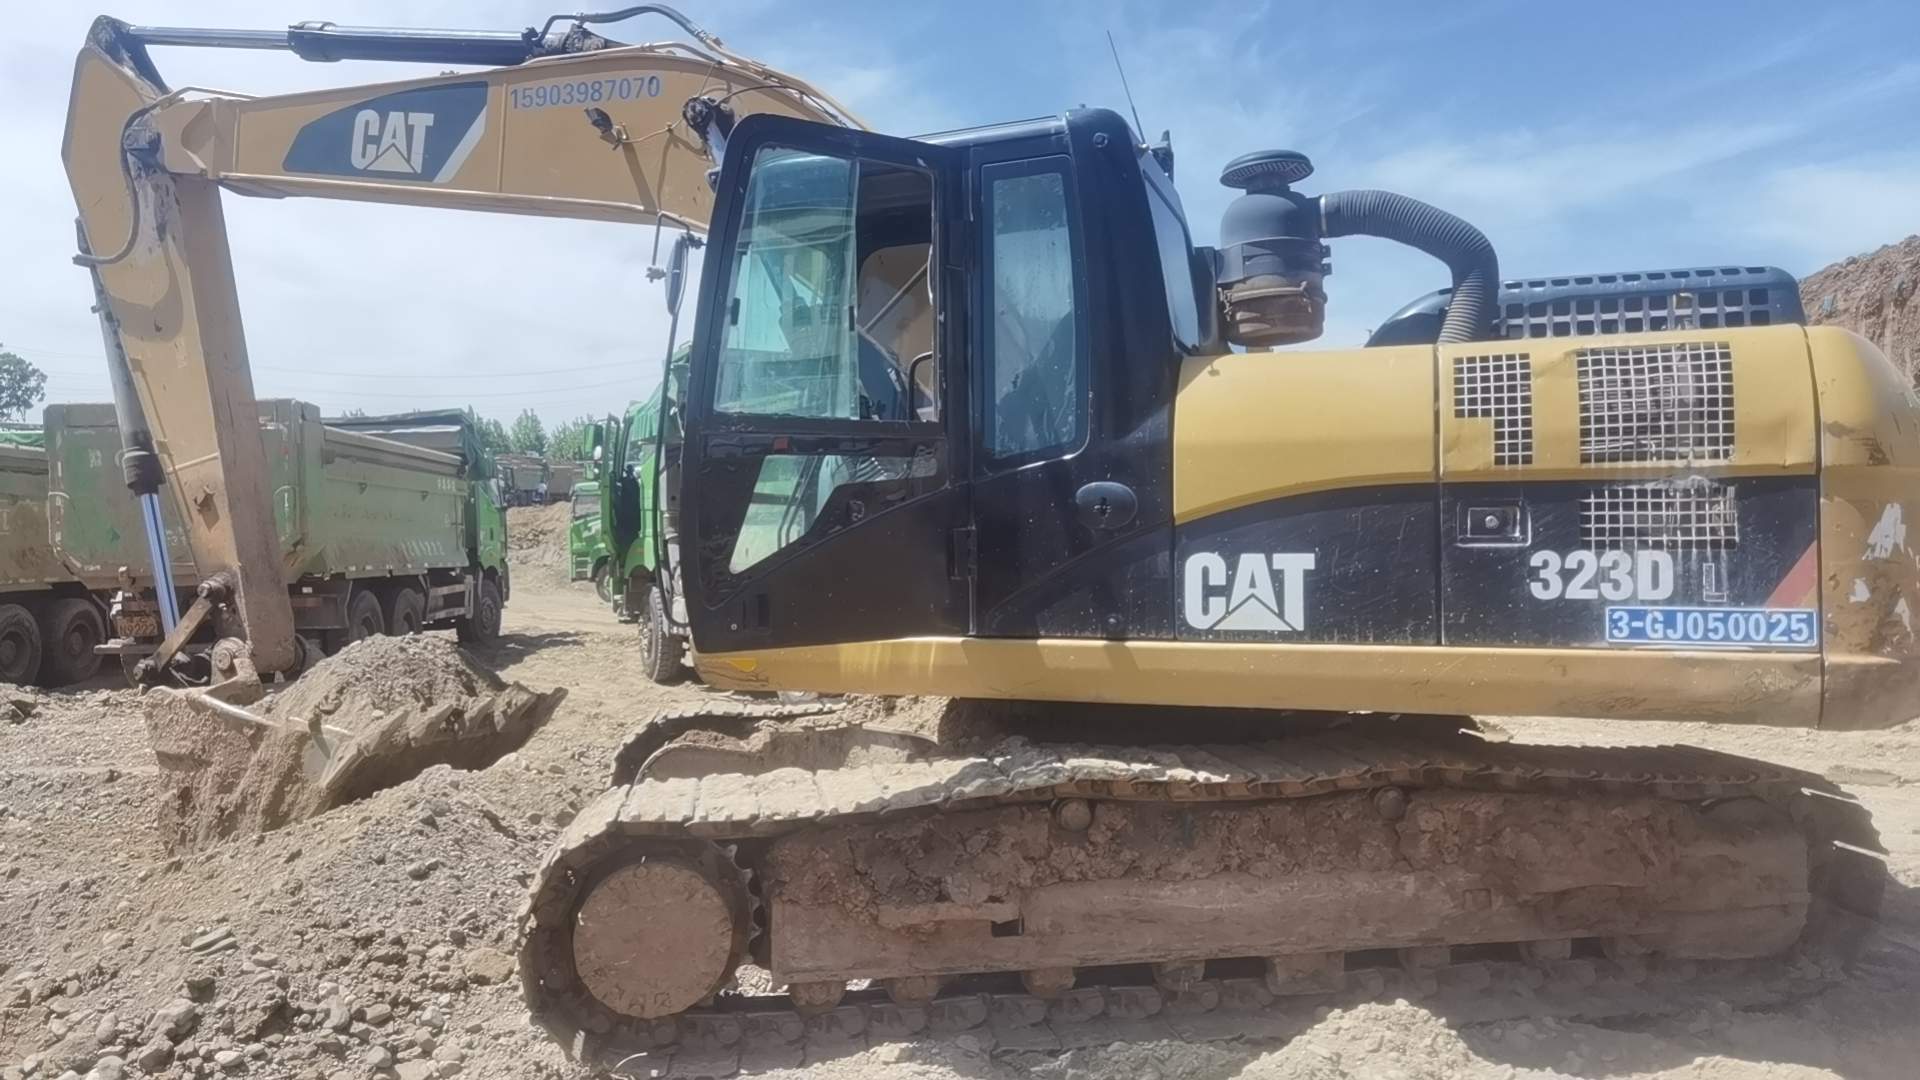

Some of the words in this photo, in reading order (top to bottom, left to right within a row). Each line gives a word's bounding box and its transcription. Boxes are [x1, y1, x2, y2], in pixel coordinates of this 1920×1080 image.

[511, 76, 660, 109] 15903987070
[351, 109, 434, 174] CAT
[1185, 552, 1316, 631] CAT
[1530, 550, 1674, 601] 323D
[1612, 611, 1809, 642] 3-GJ050025
